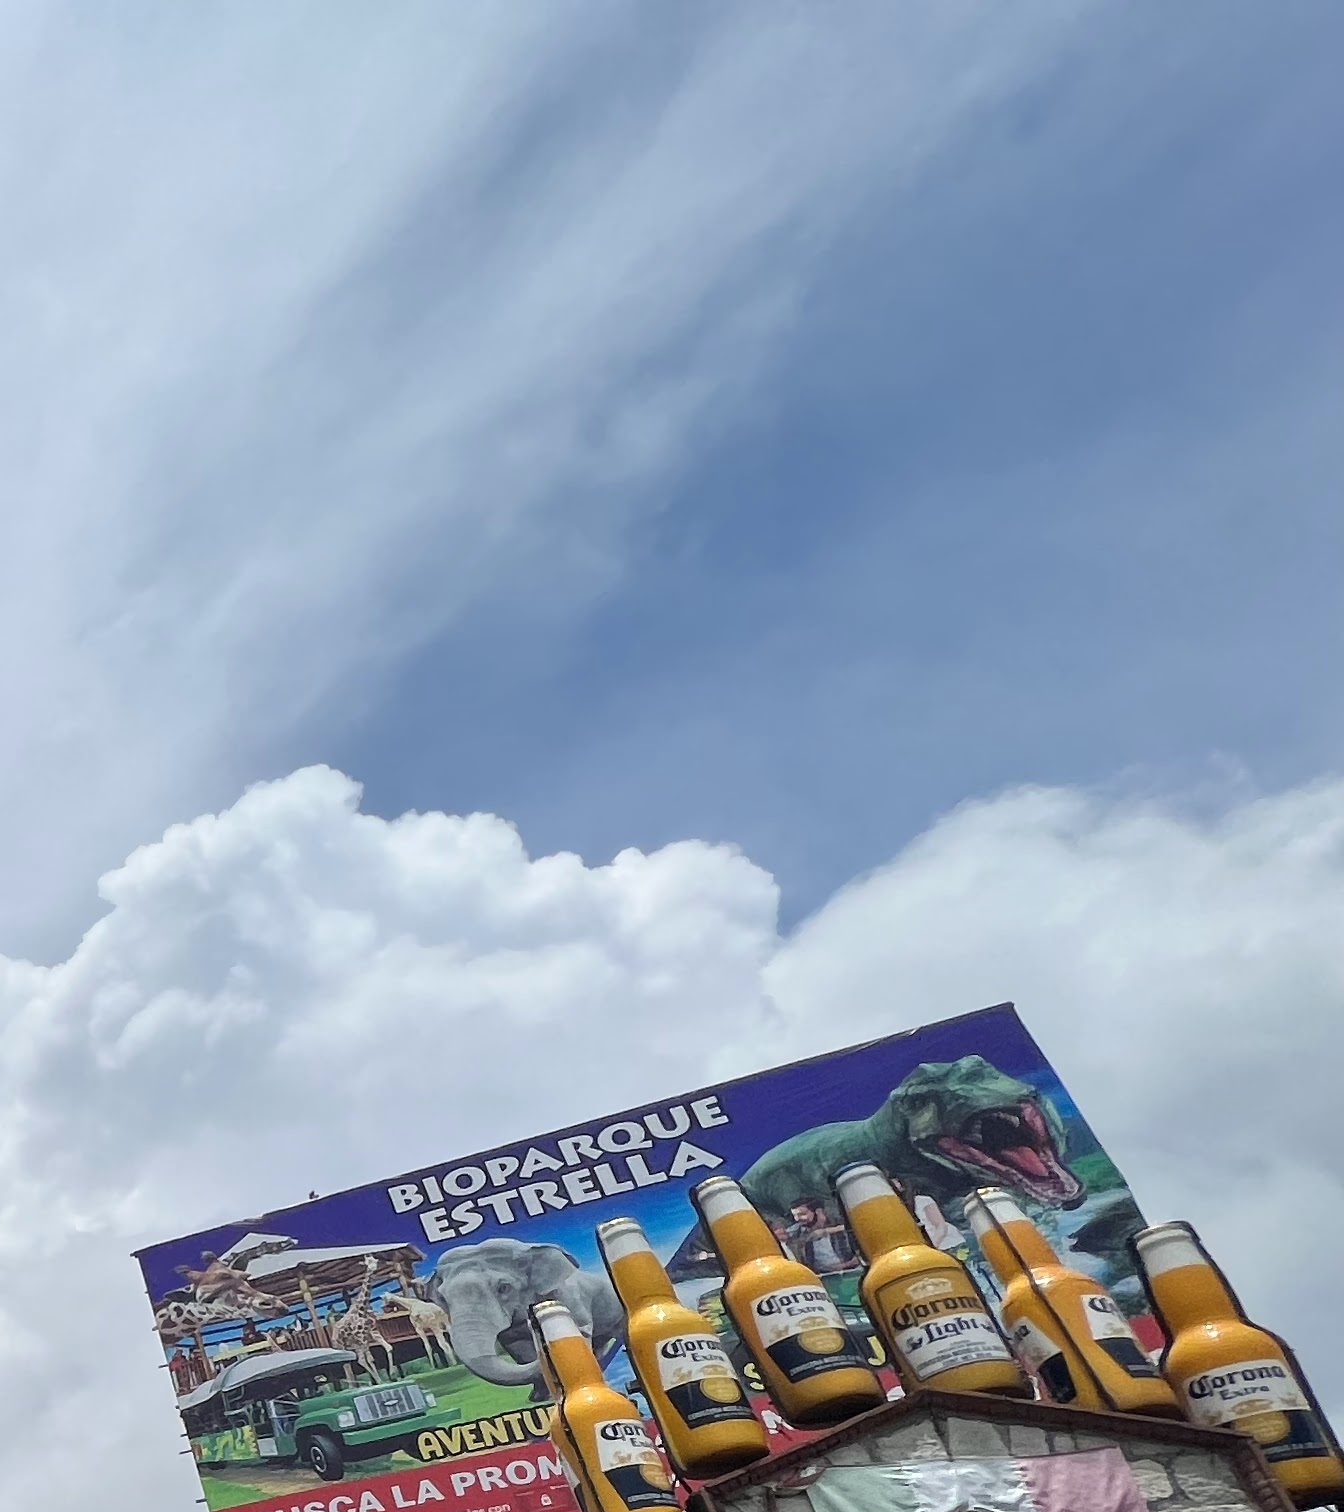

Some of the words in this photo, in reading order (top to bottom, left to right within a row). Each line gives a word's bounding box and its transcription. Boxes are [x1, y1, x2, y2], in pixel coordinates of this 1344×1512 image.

[387, 1096, 729, 1214] BIOPARQUE
[419, 1141, 724, 1243] ESTRELLA
[921, 1317, 979, 1345] Light
[1189, 1366, 1286, 1399] Corona
[391, 1479, 446, 1509] LA
